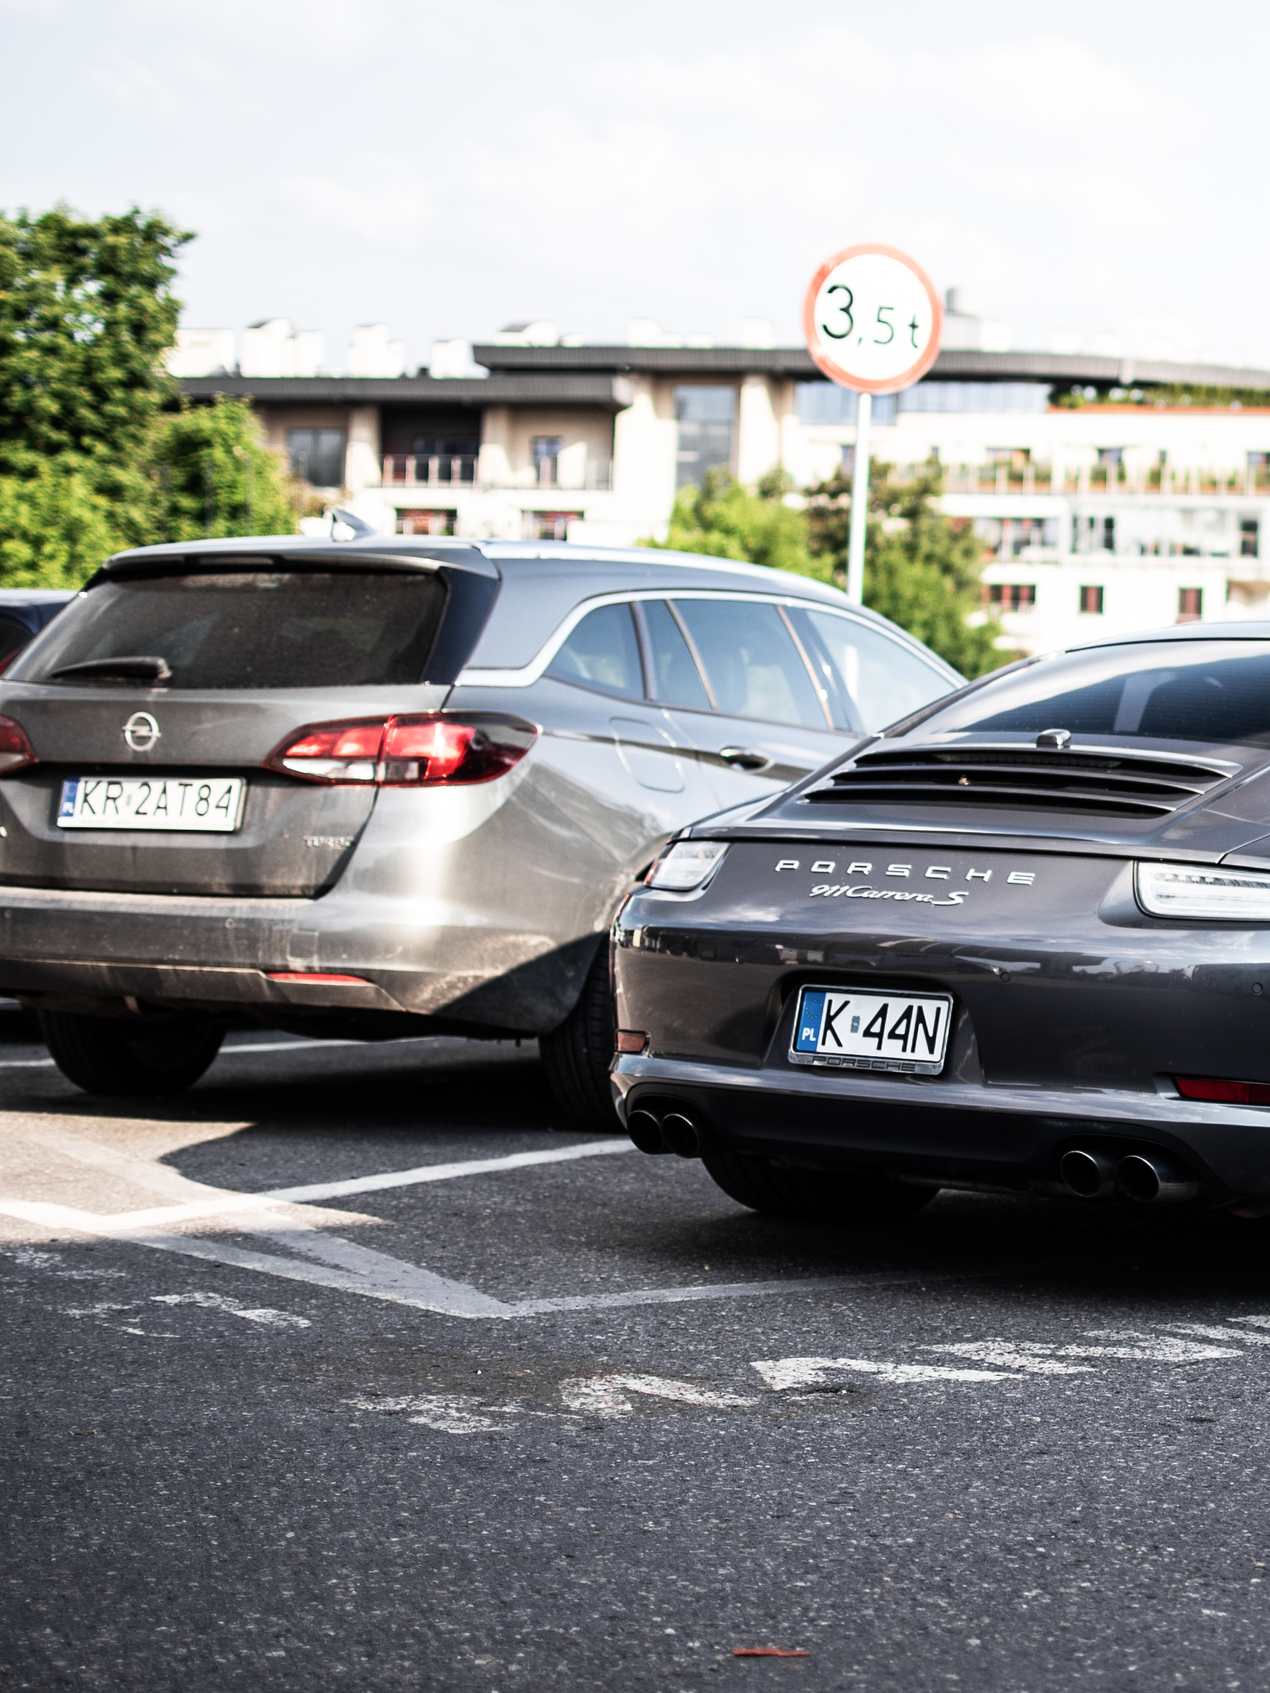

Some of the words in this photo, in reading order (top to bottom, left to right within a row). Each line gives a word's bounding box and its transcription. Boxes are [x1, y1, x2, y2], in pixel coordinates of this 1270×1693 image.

[822, 284, 894, 346] 3,5
[908, 314, 919, 349] t
[80, 780, 124, 815] KR
[135, 781, 233, 818] 2AT84
[775, 859, 1036, 886] PORSCHE
[801, 1027, 817, 1042] PL
[821, 999, 851, 1048] K
[862, 1003, 942, 1055] 44N
[812, 1055, 916, 1073] PORSCHE
